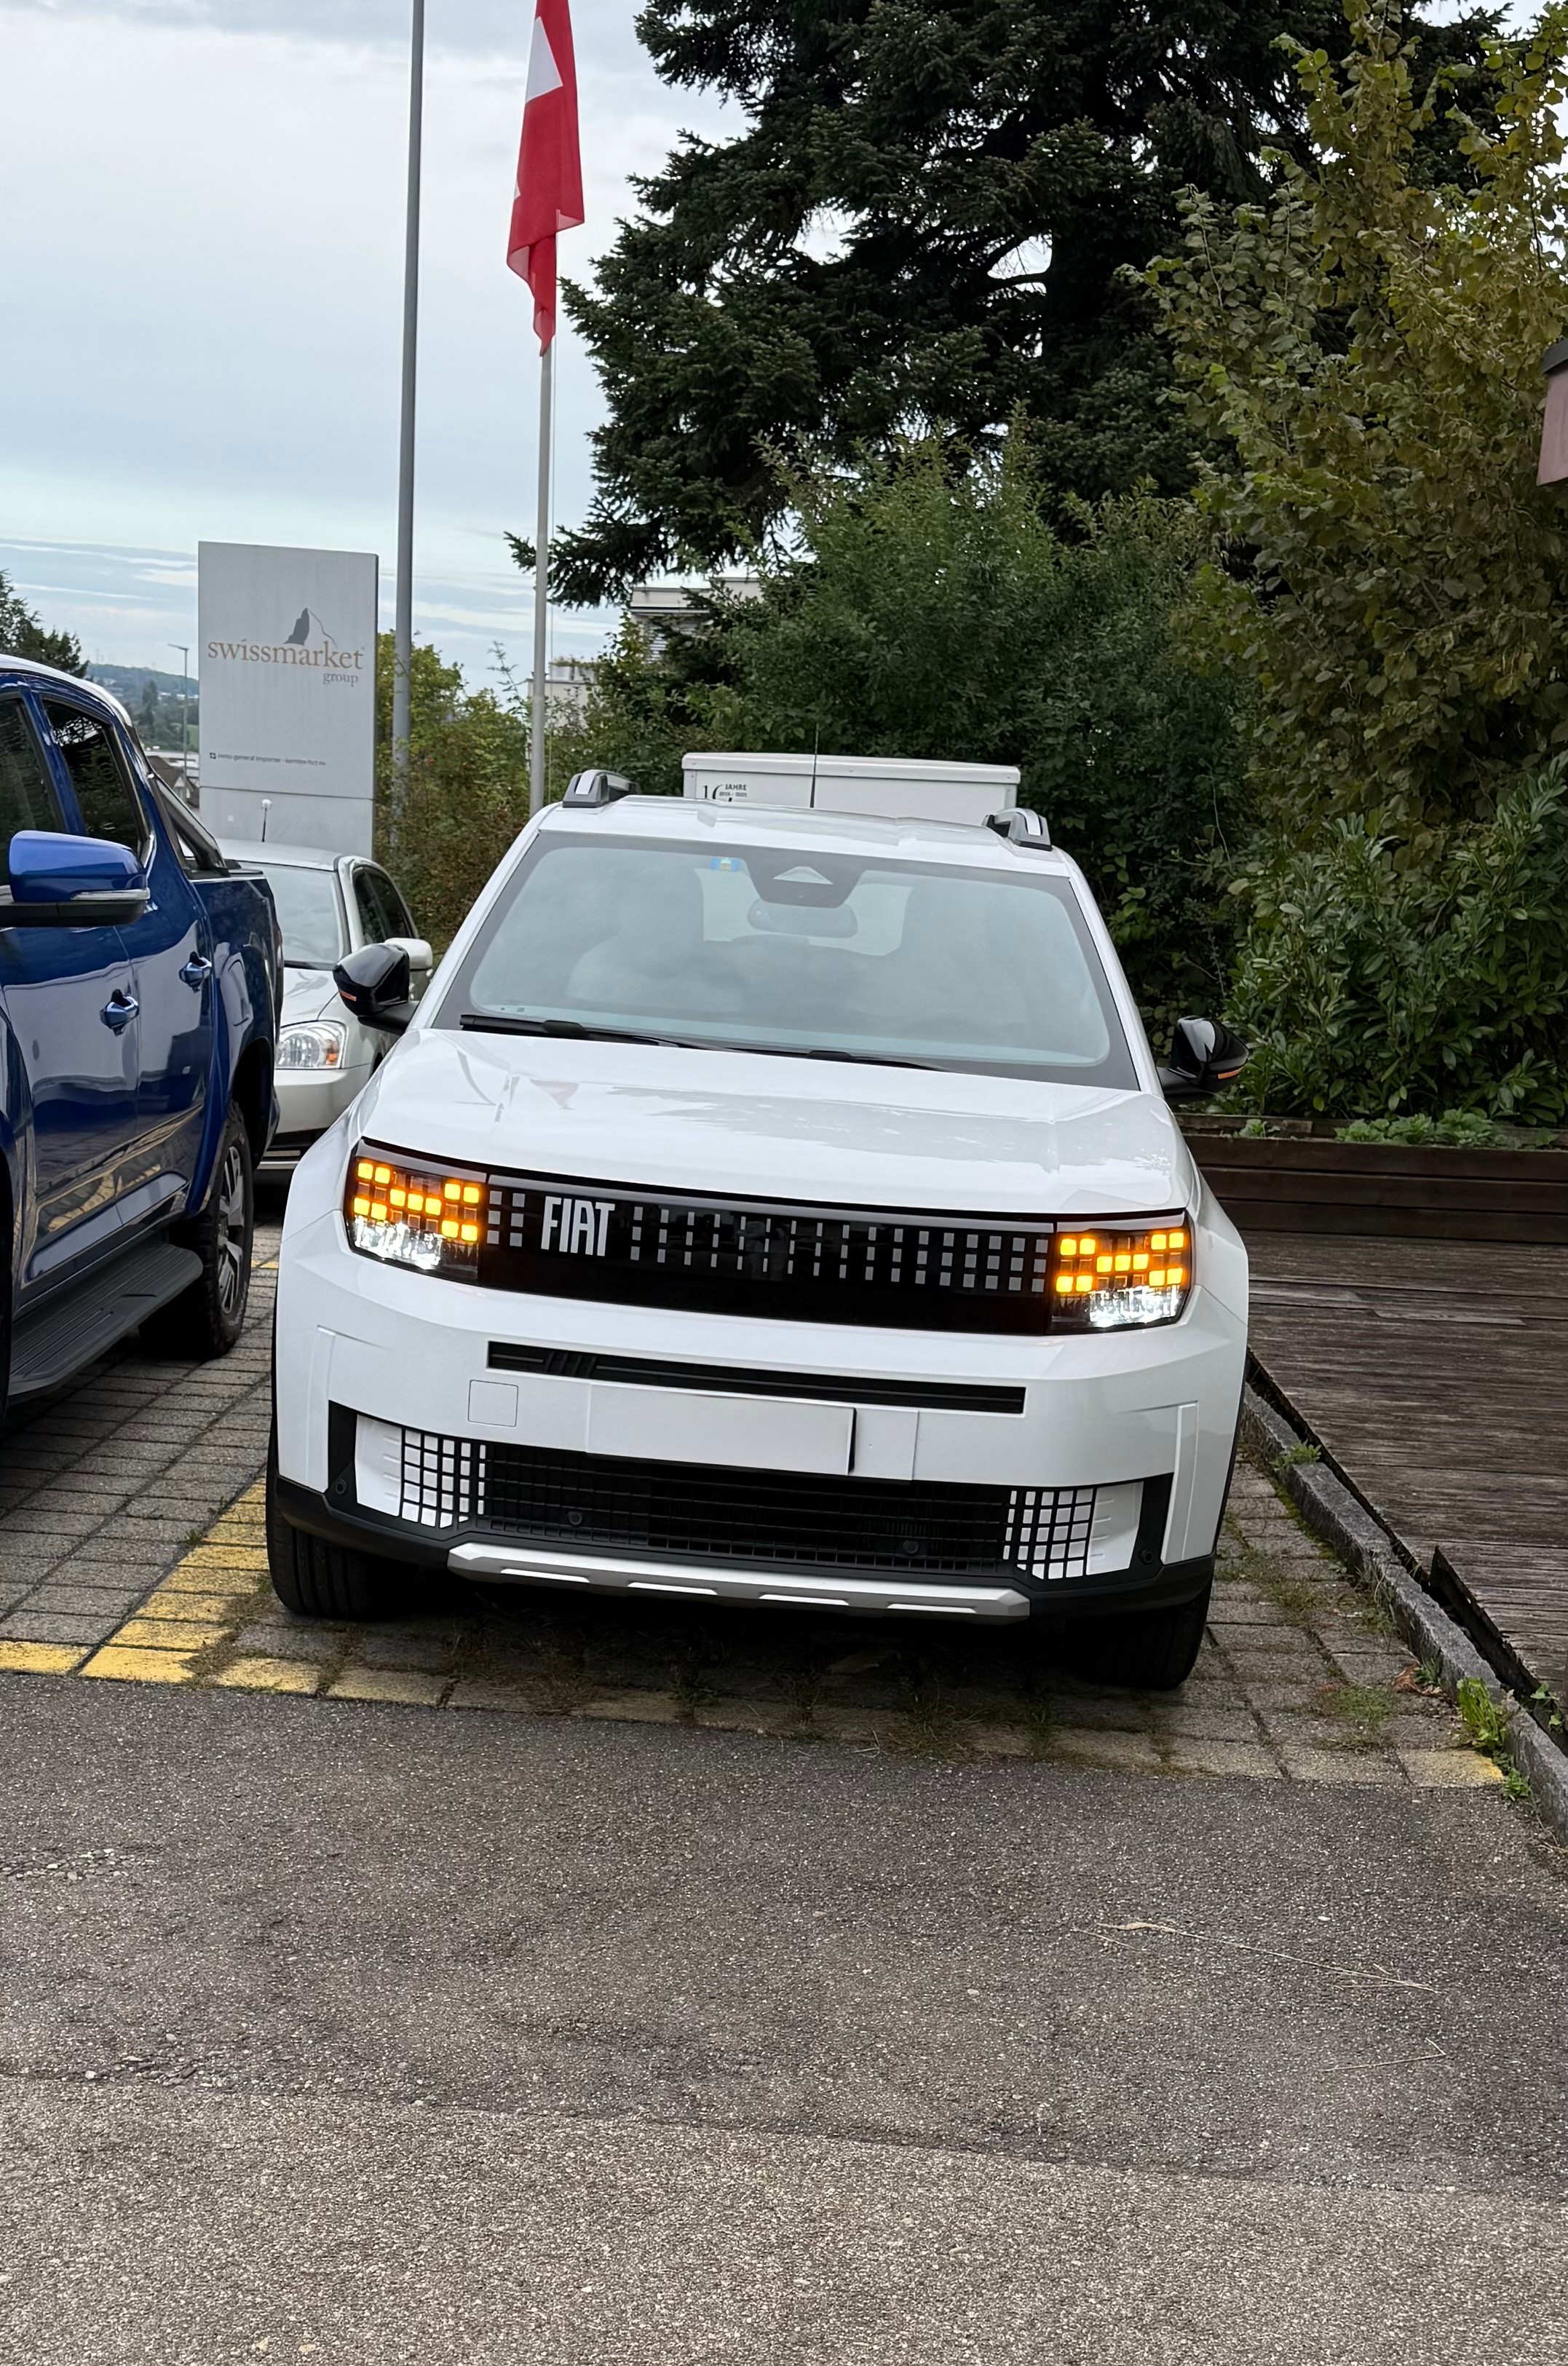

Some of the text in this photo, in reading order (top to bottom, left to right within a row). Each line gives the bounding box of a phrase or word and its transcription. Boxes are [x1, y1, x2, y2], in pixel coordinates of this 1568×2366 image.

[207, 639, 363, 670] swissmarket
[322, 673, 359, 687] group
[541, 1196, 615, 1257] FIAT
